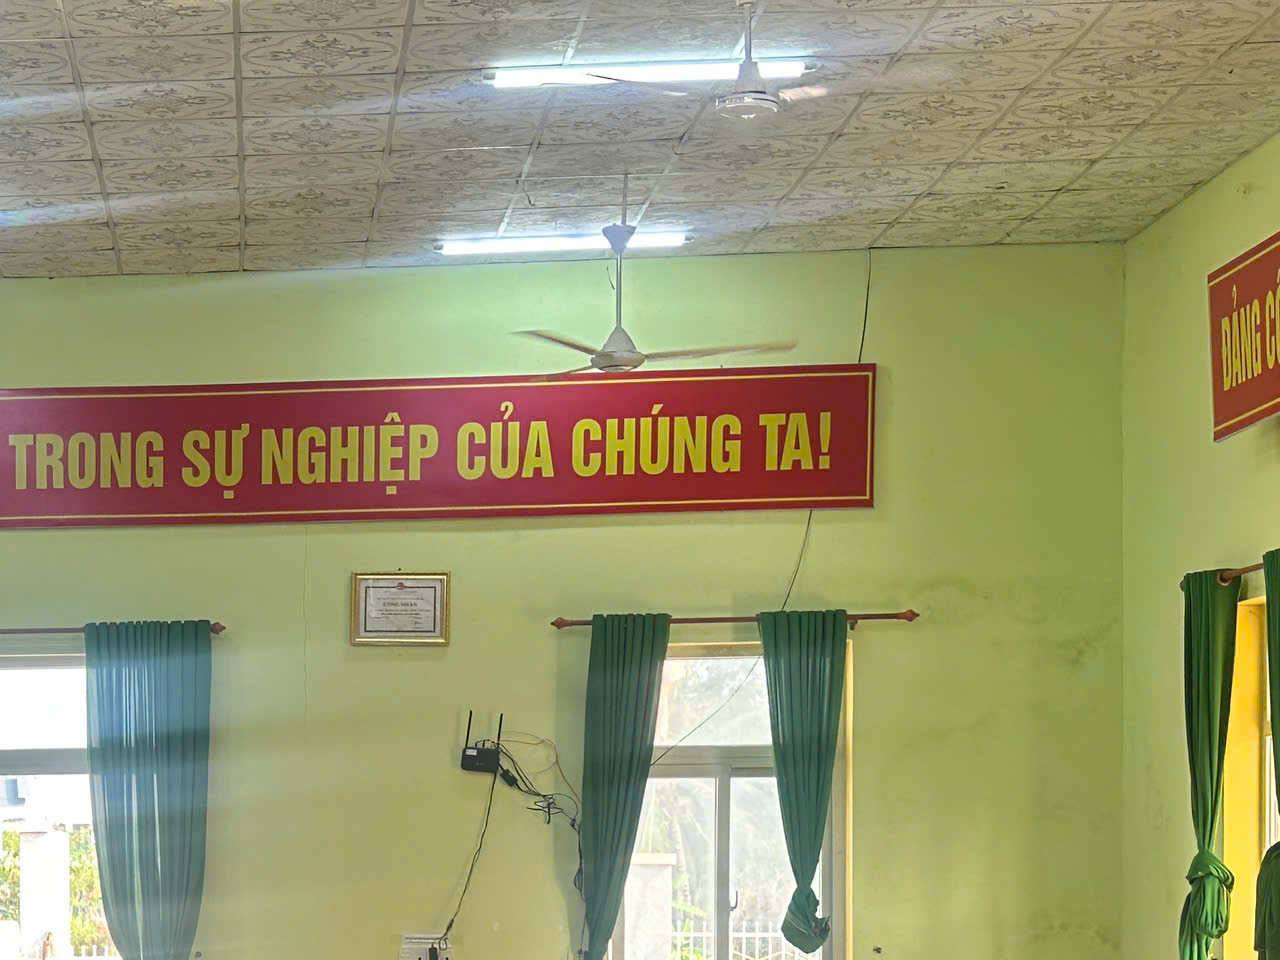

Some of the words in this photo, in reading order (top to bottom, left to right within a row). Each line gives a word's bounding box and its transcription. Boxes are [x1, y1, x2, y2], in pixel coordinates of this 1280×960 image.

[1221, 284, 1262, 392] ĐẢNG
[8, 430, 163, 489] TRONG
[182, 424, 249, 498] SỰ
[262, 412, 439, 494] NGHIỆP
[457, 402, 554, 480] CỦA
[572, 404, 741, 477] CHÚNG
[760, 412, 831, 471] TA!
